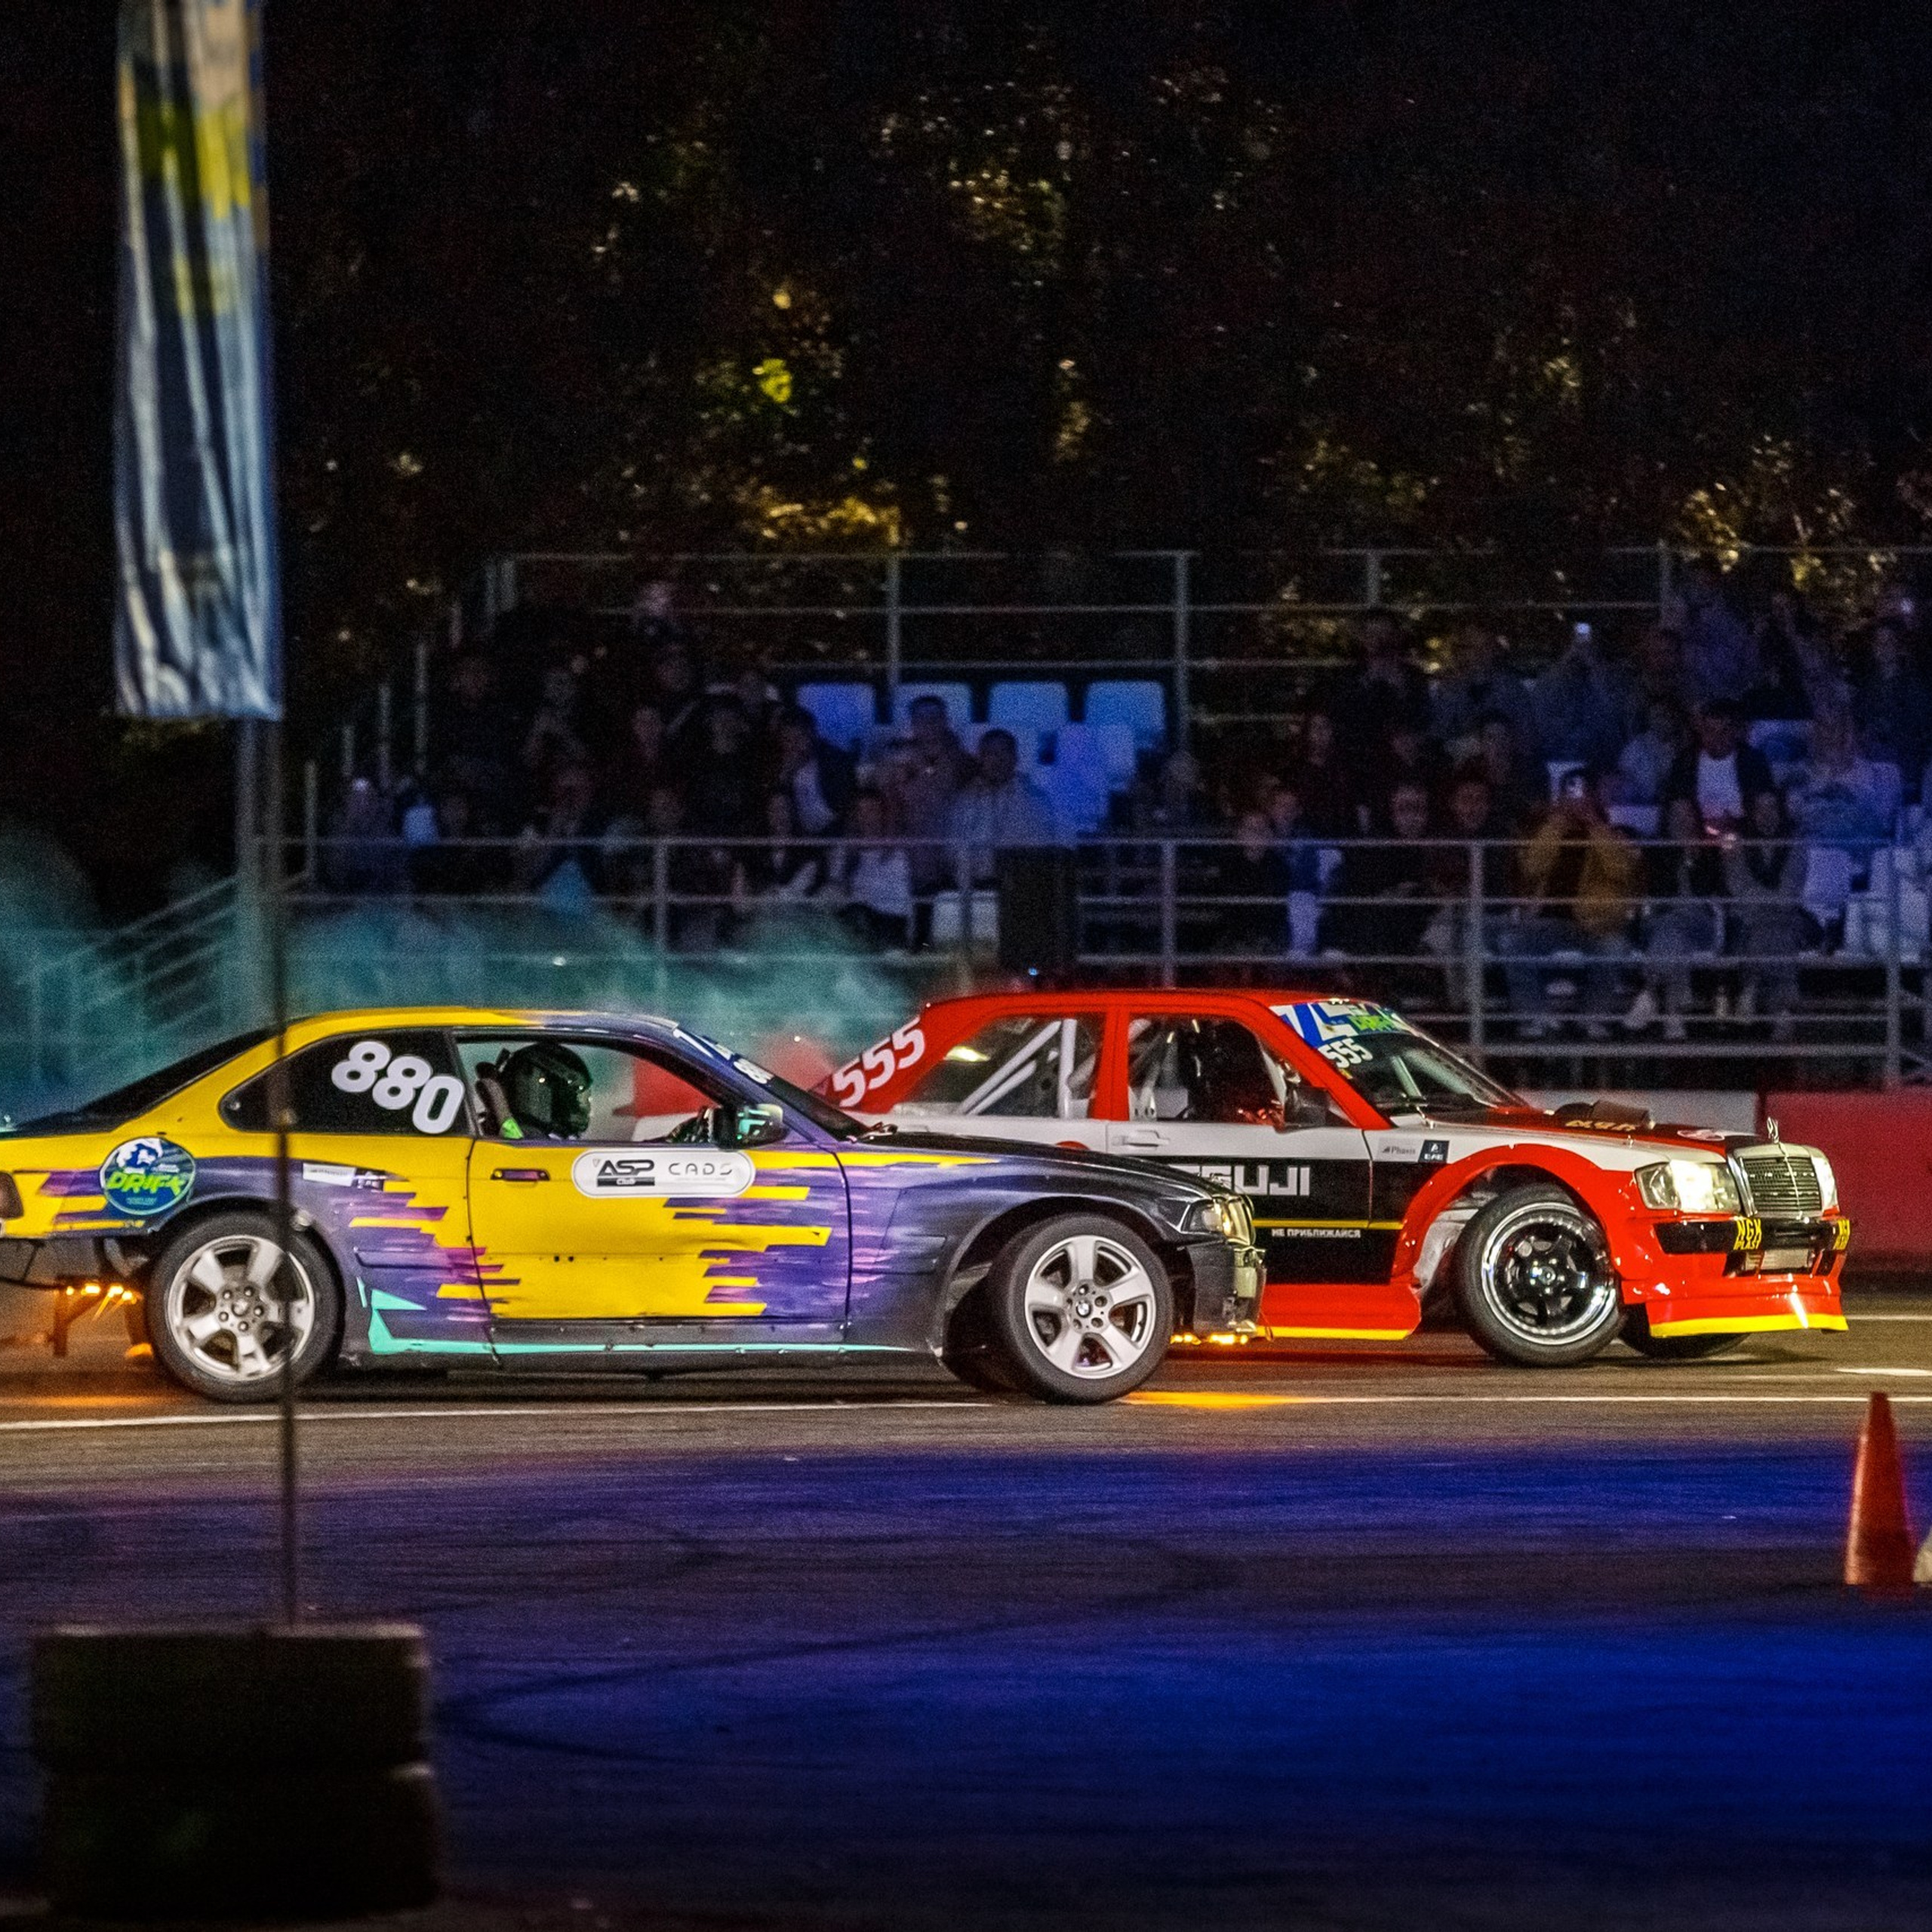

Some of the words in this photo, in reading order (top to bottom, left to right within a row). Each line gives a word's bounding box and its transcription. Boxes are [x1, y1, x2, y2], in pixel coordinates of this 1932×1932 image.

[832, 1017, 925, 1107] 555
[1318, 1038, 1374, 1069] 555
[331, 1041, 465, 1134] 880
[598, 1159, 654, 1176] ASP
[106, 1171, 186, 1196] DRIFT
